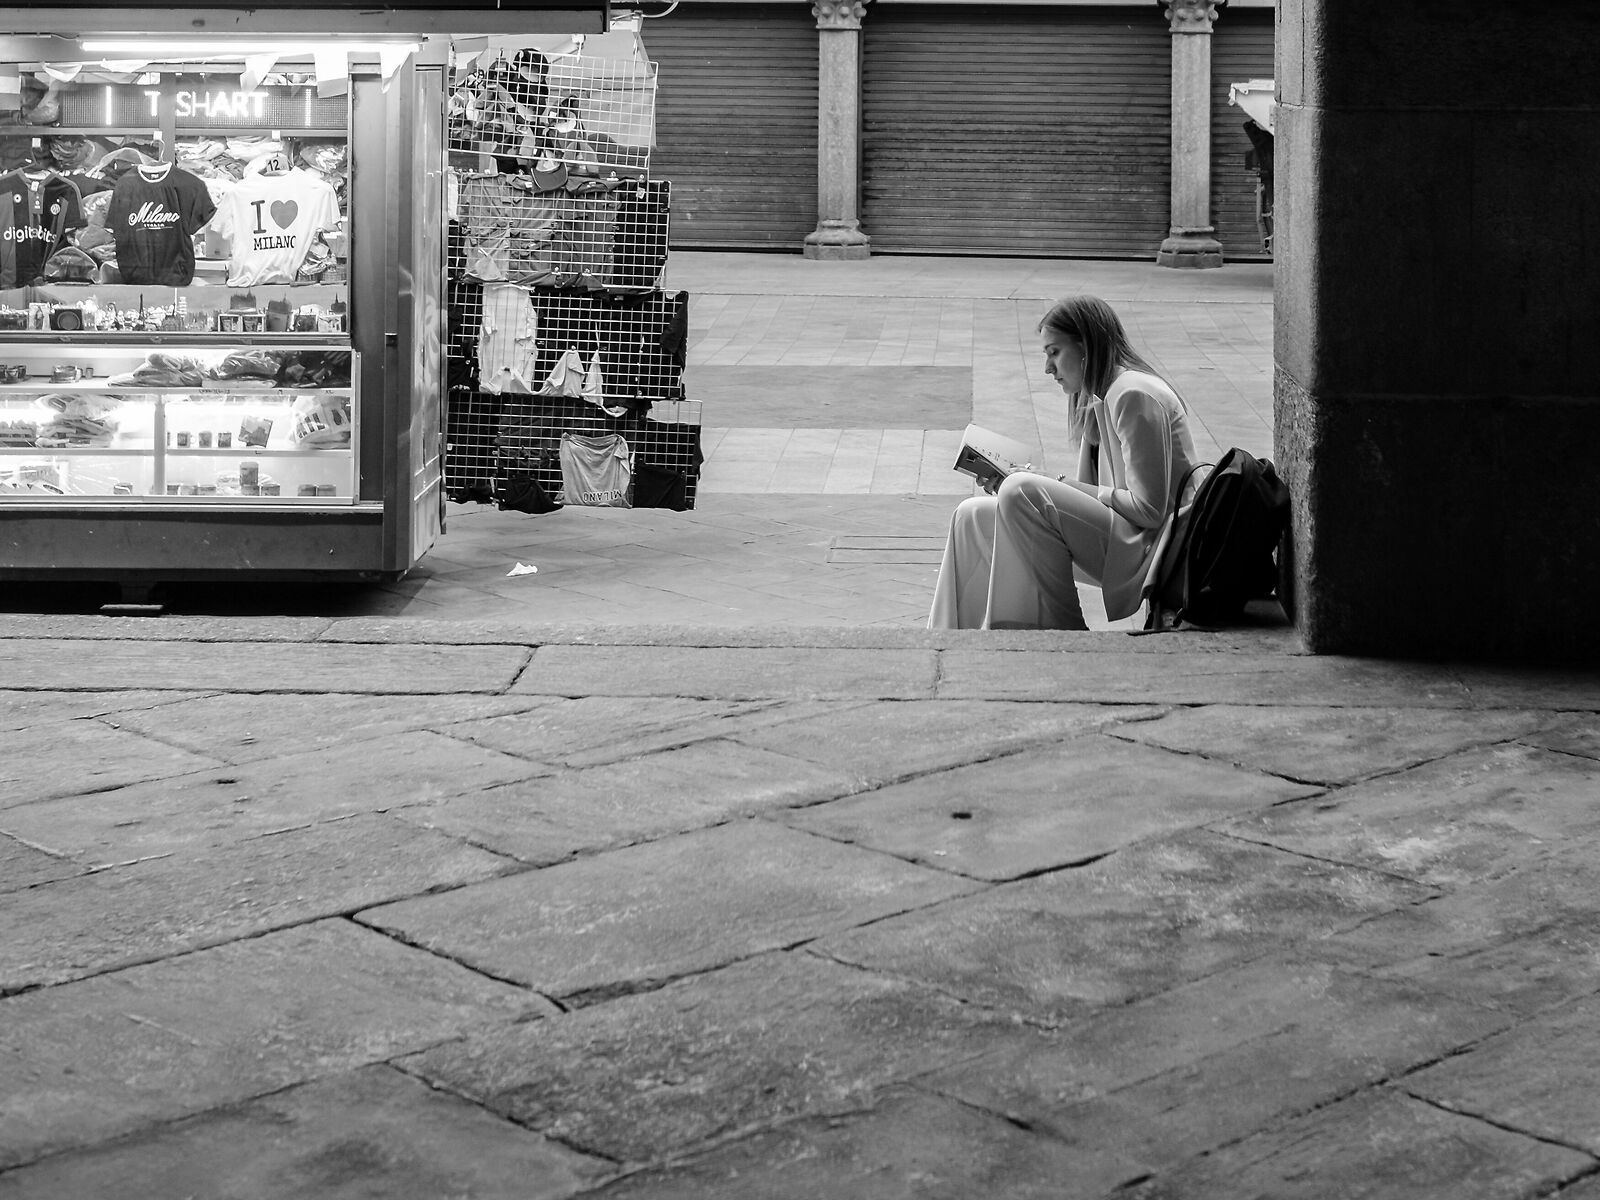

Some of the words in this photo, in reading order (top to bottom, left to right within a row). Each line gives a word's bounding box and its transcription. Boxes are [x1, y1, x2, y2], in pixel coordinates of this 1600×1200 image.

[144, 90, 161, 117] T
[268, 159, 280, 172] 12
[128, 201, 180, 226] Milano
[250, 199, 267, 234] I
[583, 490, 622, 502] MILANO
